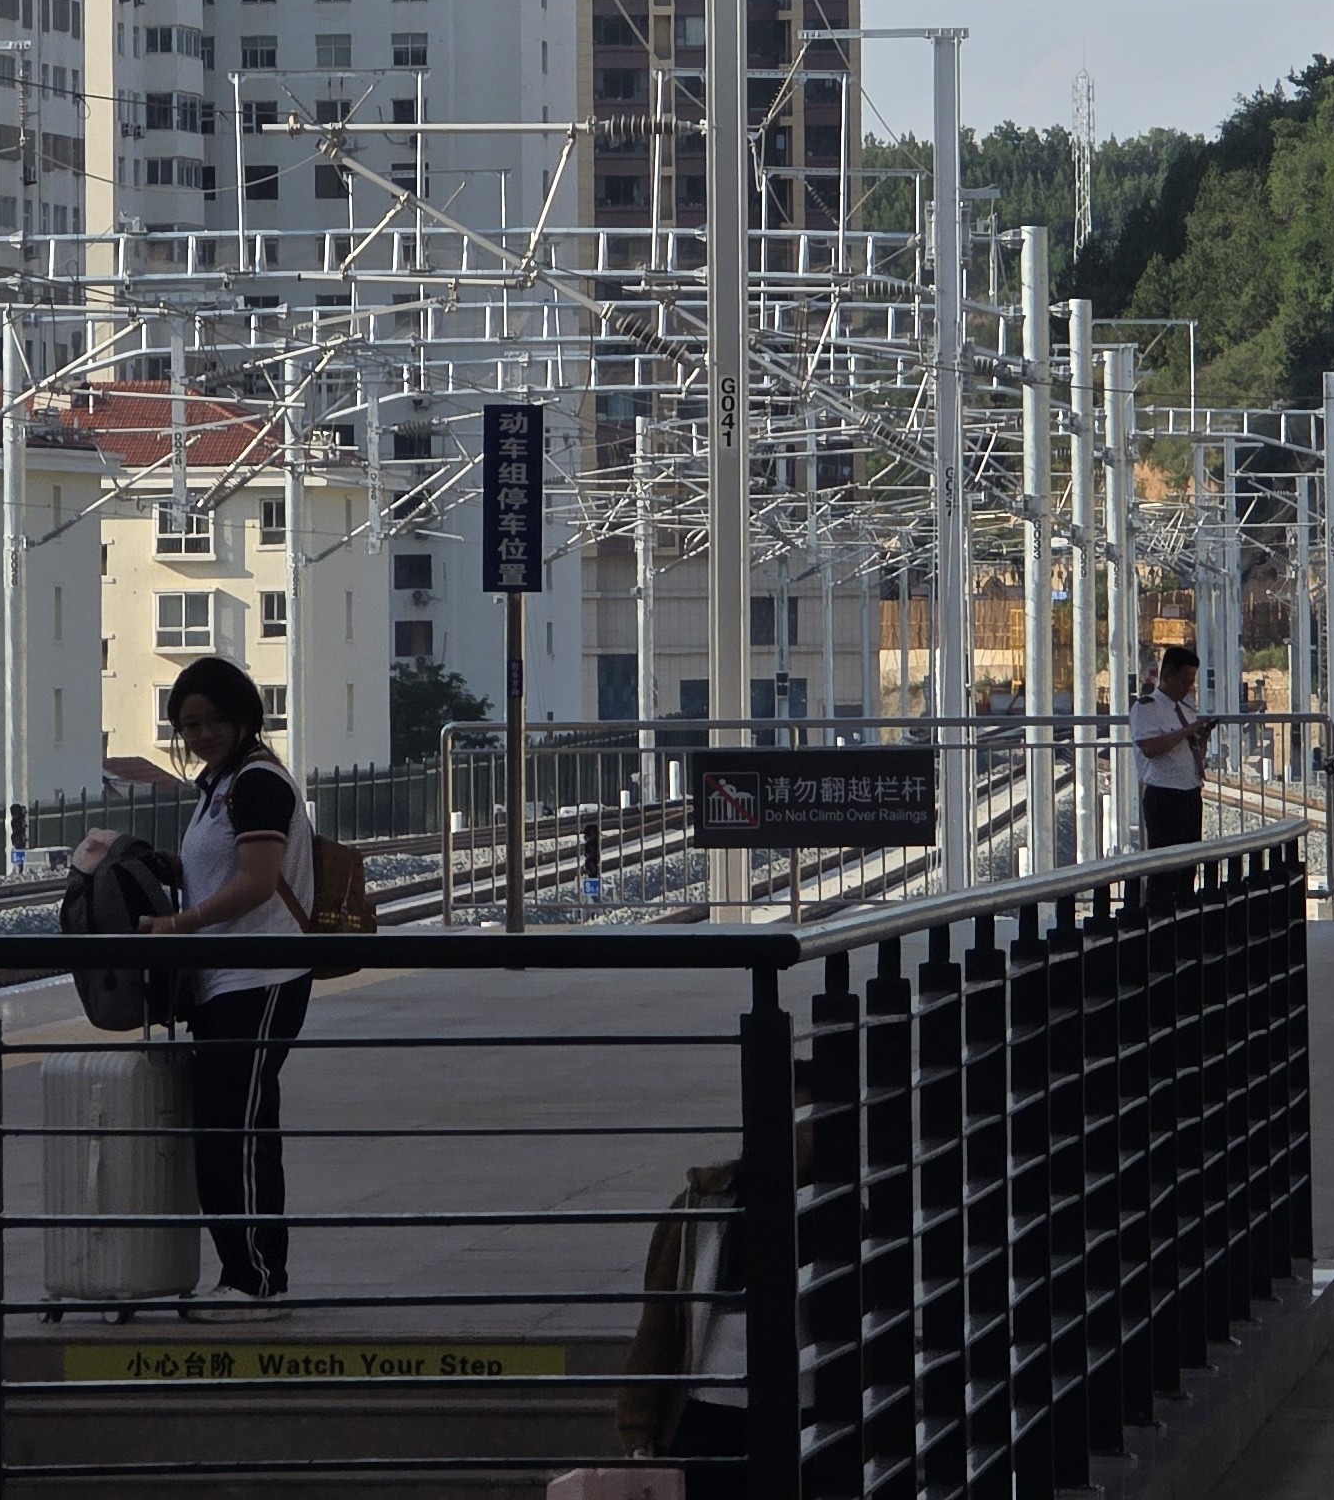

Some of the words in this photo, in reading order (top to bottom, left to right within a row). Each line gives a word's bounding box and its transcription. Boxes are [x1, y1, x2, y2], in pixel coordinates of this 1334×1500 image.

[721, 377, 735, 447] G041
[497, 411, 528, 587] 动车组停车位置
[1033, 519, 1041, 560] G033
[765, 776, 927, 803] 请勿翻越栏杆
[765, 809, 783, 821] Do
[786, 809, 806, 821] Not
[809, 808, 844, 821] Climb
[847, 808, 877, 821] Over
[879, 808, 927, 823] Railings
[126, 1352, 235, 1378] 小心台阶
[258, 1353, 345, 1376] Watch
[360, 1353, 424, 1376] Your
[440, 1353, 503, 1377] Step
